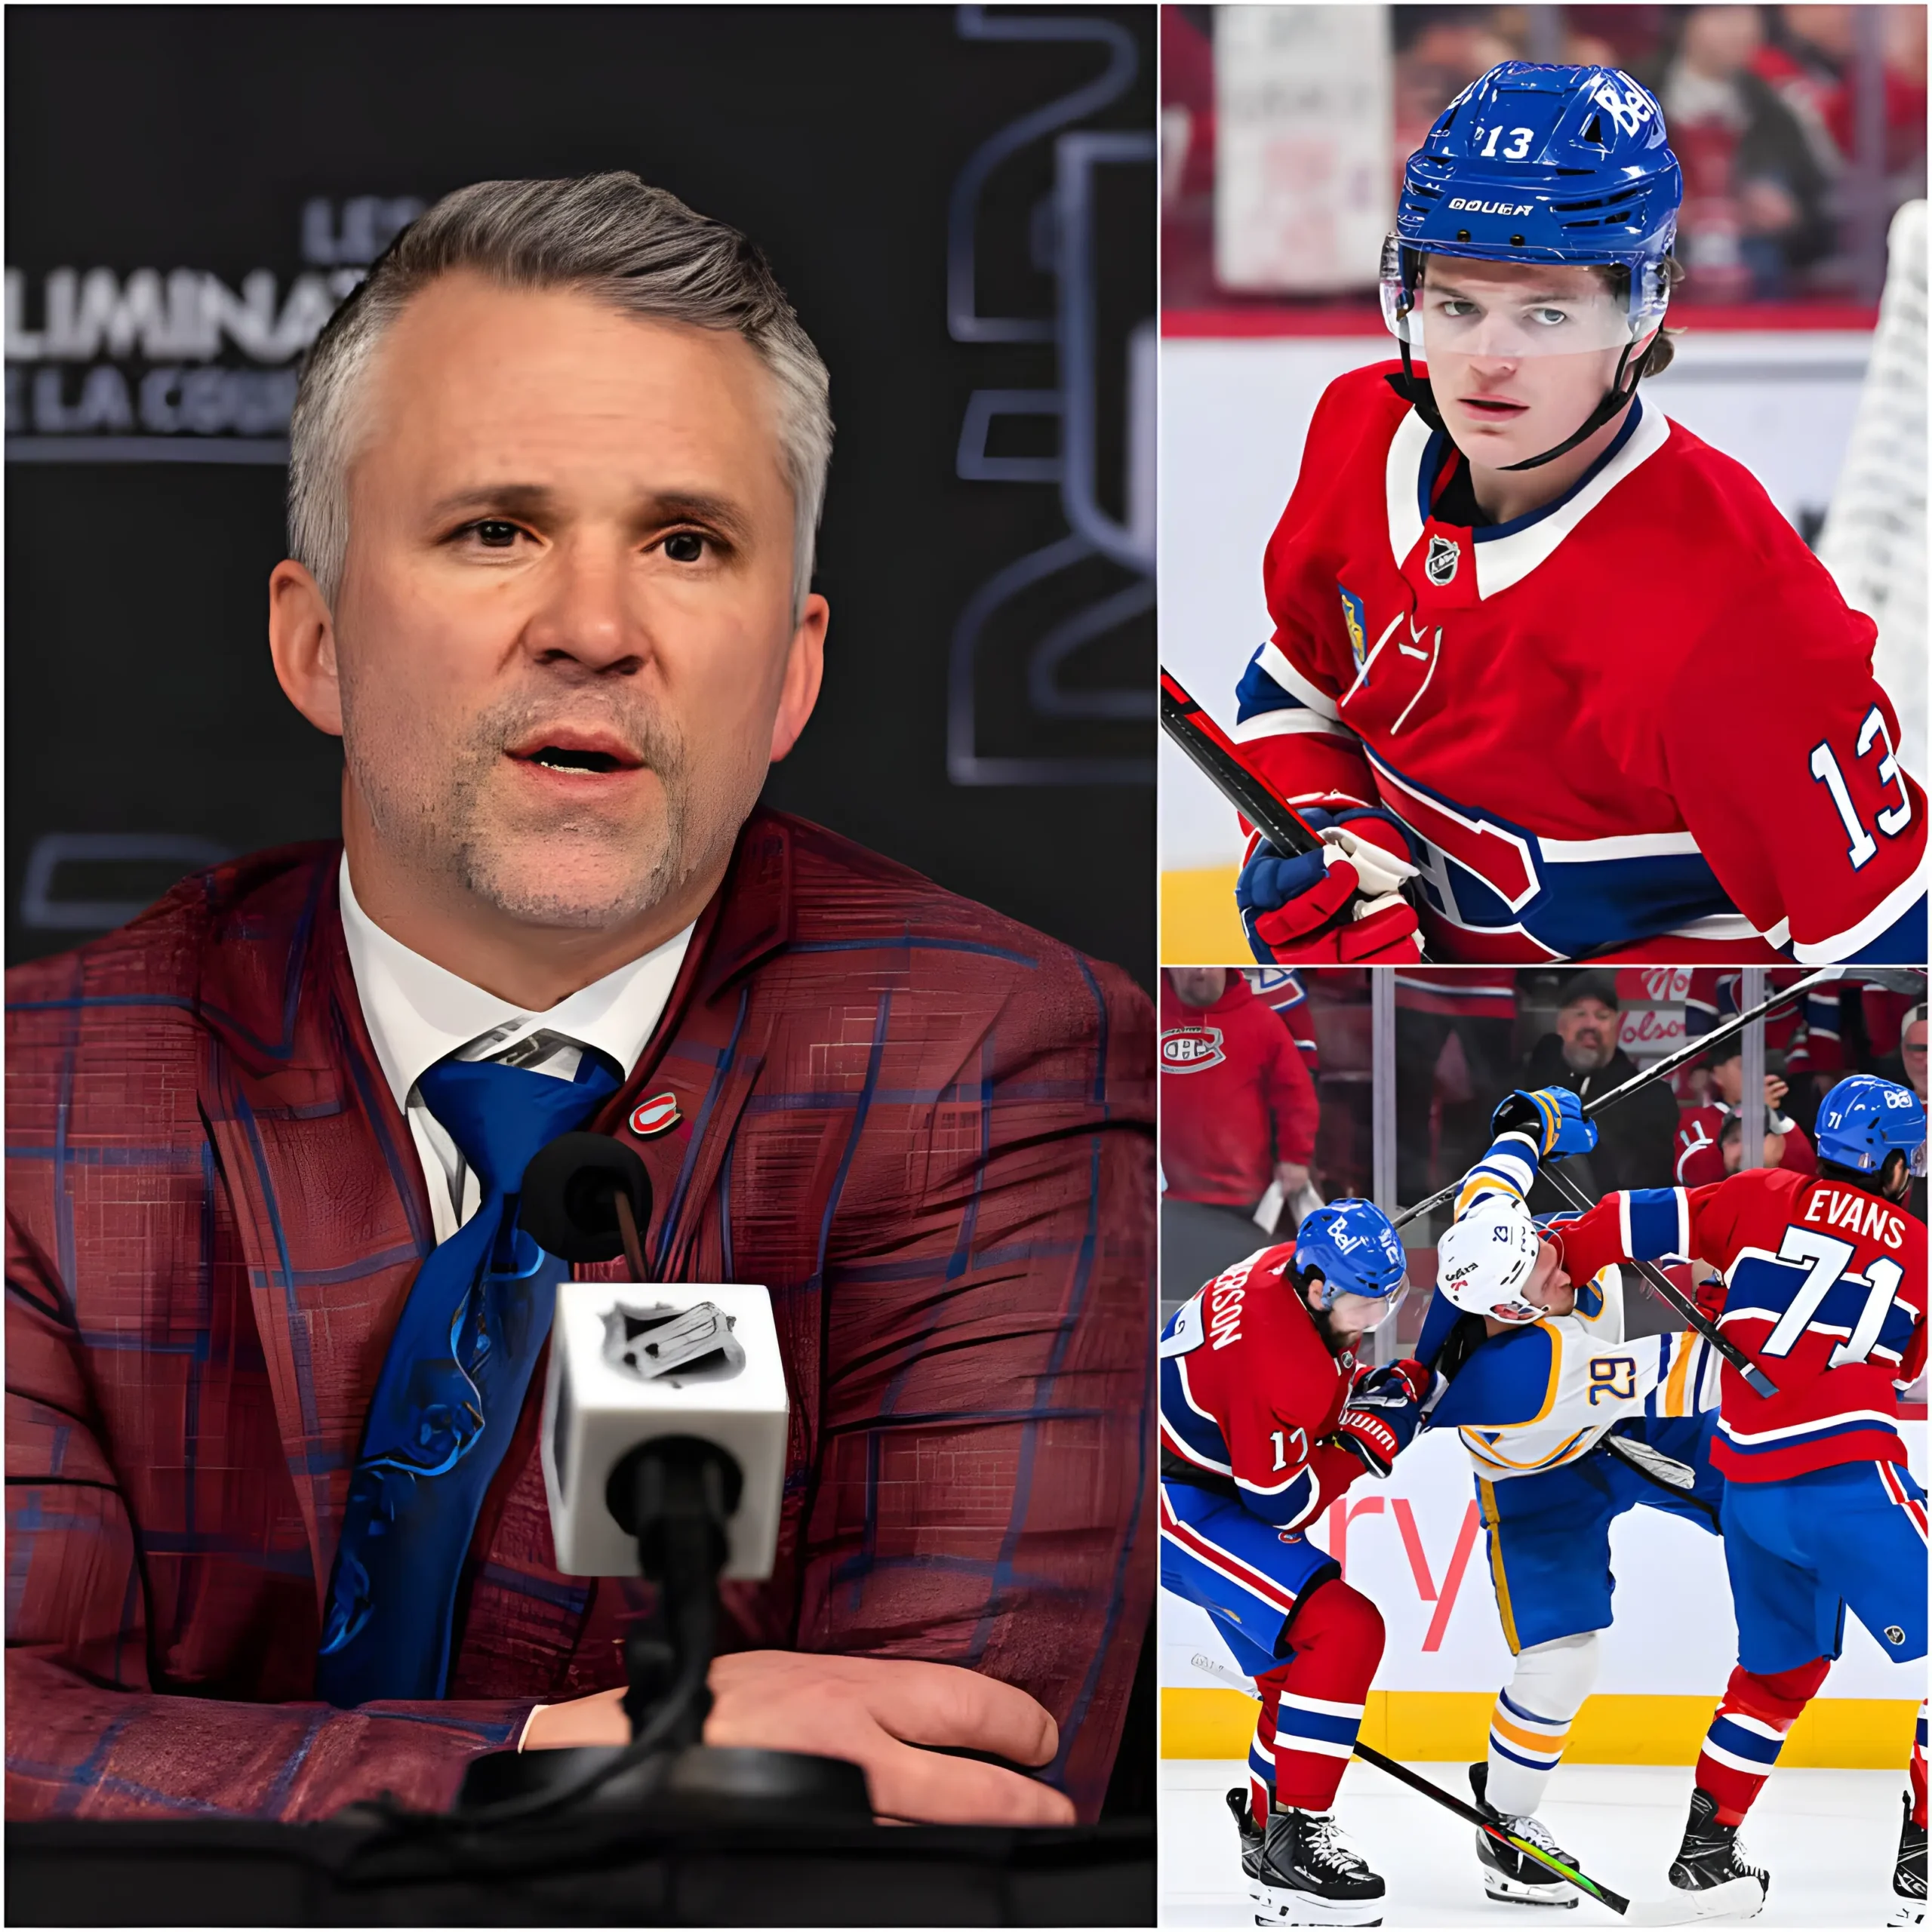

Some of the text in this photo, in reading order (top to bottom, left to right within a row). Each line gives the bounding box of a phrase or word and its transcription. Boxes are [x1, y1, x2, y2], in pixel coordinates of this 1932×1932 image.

[1594, 70, 1657, 138] Bell
[1481, 125, 1534, 159] 13
[35, 366, 133, 432] LA
[1808, 701, 1912, 873] 13
[1828, 1112, 1842, 1129] 71
[1804, 1189, 1906, 1249] EVANS
[1758, 1223, 1905, 1370] 71
[1588, 1358, 1636, 1405] 29
[1269, 1426, 1308, 1472] 17
[1330, 1496, 1482, 1651] ry
